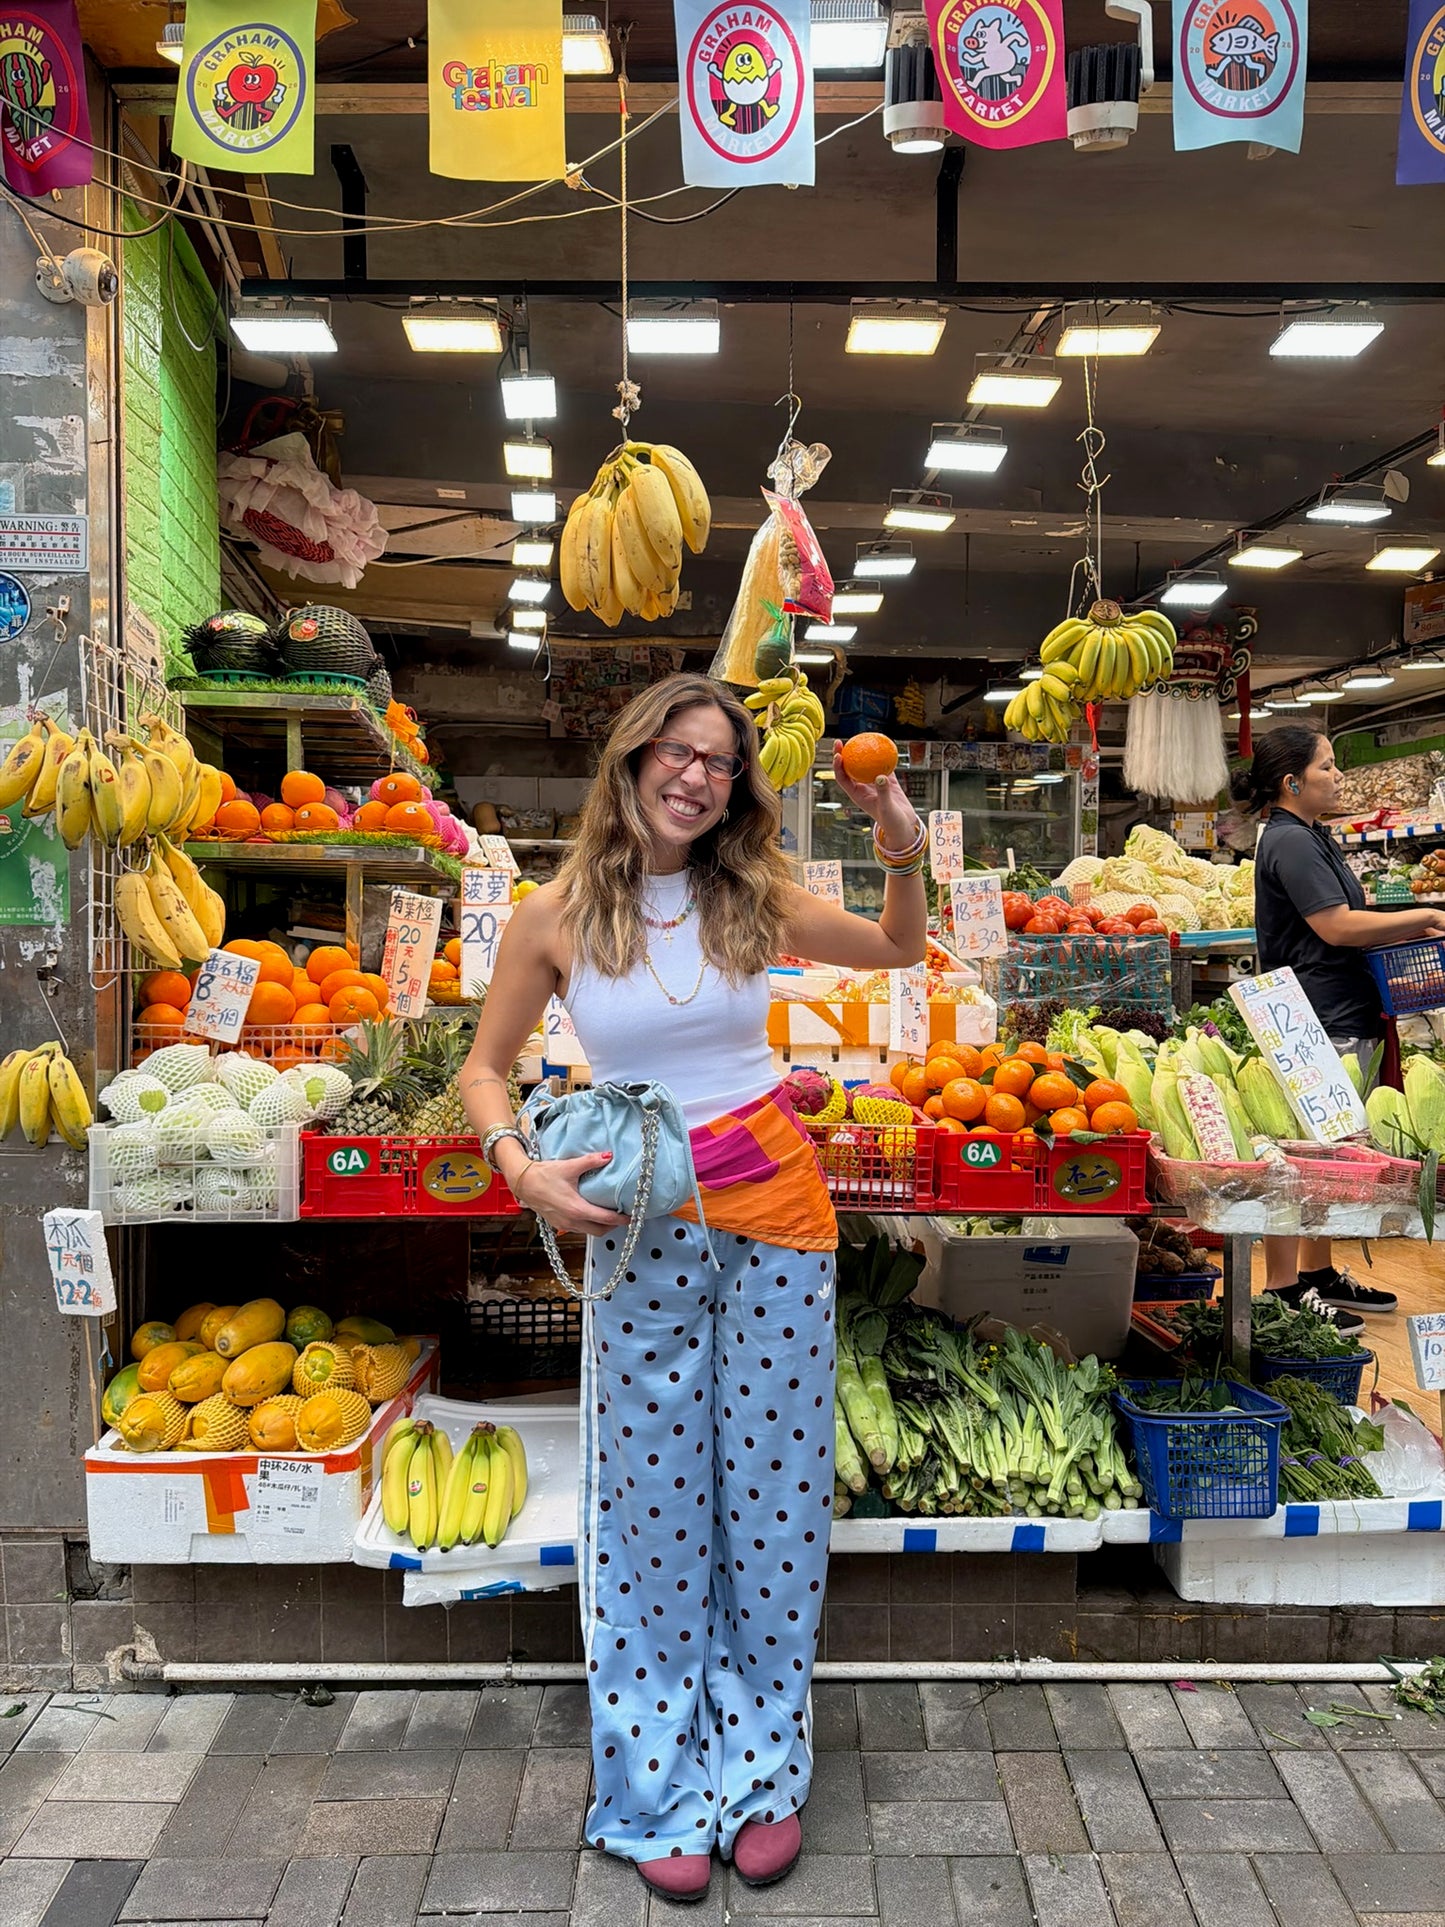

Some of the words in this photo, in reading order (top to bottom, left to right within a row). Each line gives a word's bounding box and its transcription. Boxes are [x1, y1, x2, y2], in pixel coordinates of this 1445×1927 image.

[698, 11, 773, 63] GRAHAM
[1035, 44, 1046, 52] 26
[204, 33, 280, 71] GRAHAM
[442, 59, 548, 88] Graham
[58, 85, 69, 93] 26
[452, 82, 537, 111] festival
[953, 77, 1024, 121] MARKET
[1198, 79, 1272, 111] MARKET
[201, 109, 274, 147] MARKET
[703, 115, 776, 155] MARKET
[0, 520, 58, 532] WARNING:
[35, 558, 80, 566] INSTALLED
[391, 894, 437, 921] 有葉橙
[333, 1149, 365, 1171] 6A
[967, 1143, 997, 1163] 6A
[48, 1217, 91, 1249] 木瓜
[259, 1470, 270, 1481] 果
